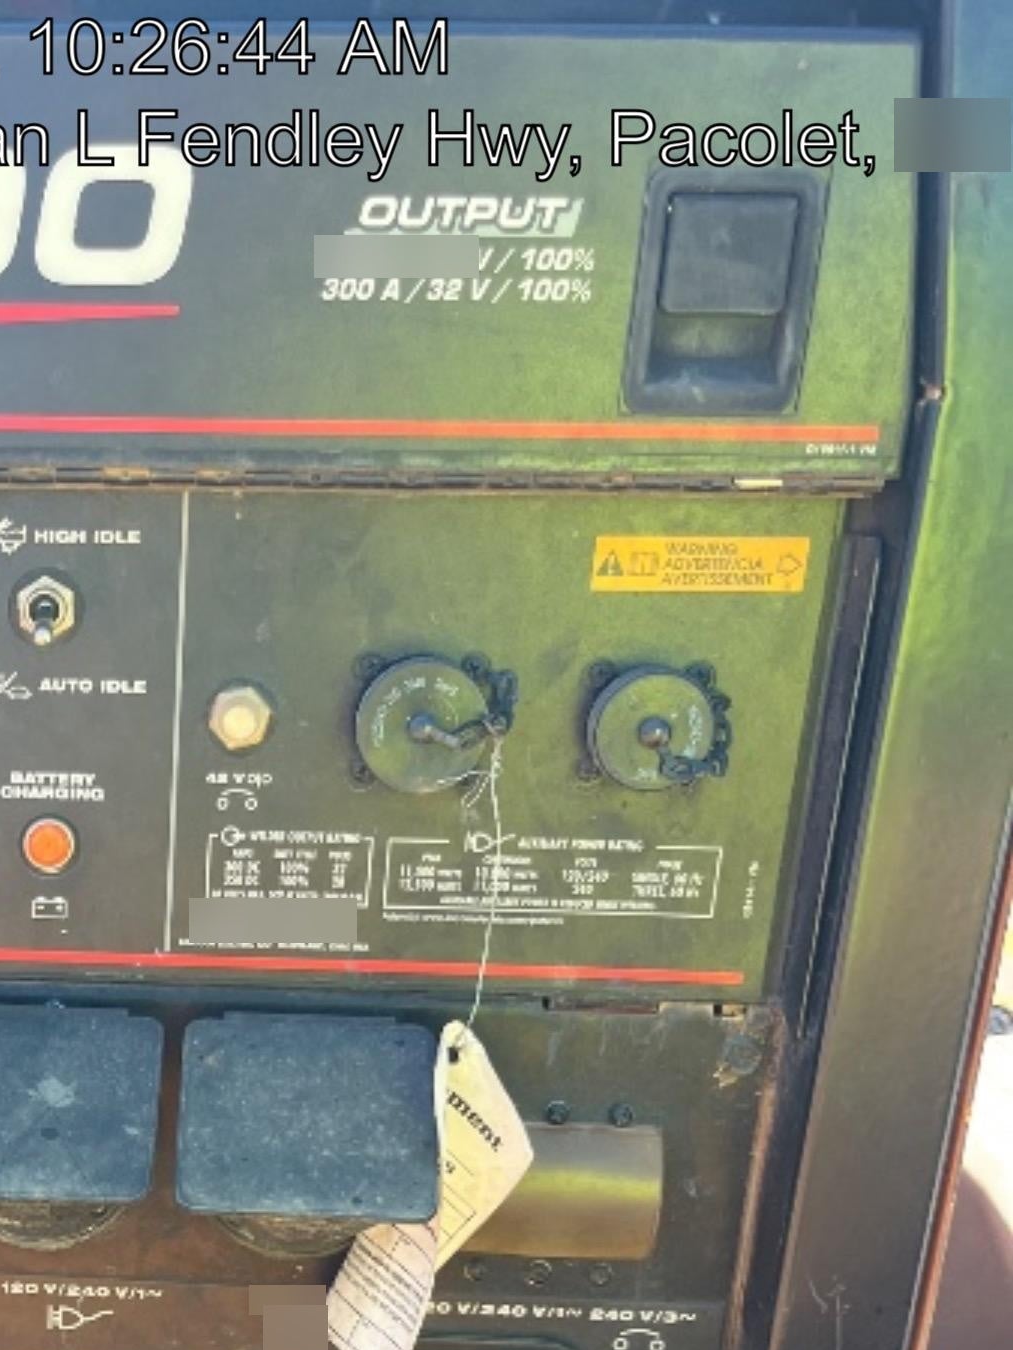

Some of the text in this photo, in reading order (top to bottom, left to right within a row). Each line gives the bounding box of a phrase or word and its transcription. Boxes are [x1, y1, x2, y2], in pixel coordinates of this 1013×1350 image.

[357, 196, 571, 230] OUTPUT
[520, 247, 596, 272] 100%
[320, 278, 377, 302] 300
[379, 278, 401, 302] A
[426, 278, 464, 302] 32
[470, 279, 492, 302] V
[517, 279, 593, 304] 100%
[33, 529, 141, 545] HIGH IDLE
[38, 677, 148, 695] AUTO IDLE
[10, 770, 96, 786] BATTERY
[0, 785, 105, 802] CHARGING
[447, 1086, 503, 1153] ment
[1, 1280, 39, 1295] 120
[589, 1308, 634, 1322] 240
